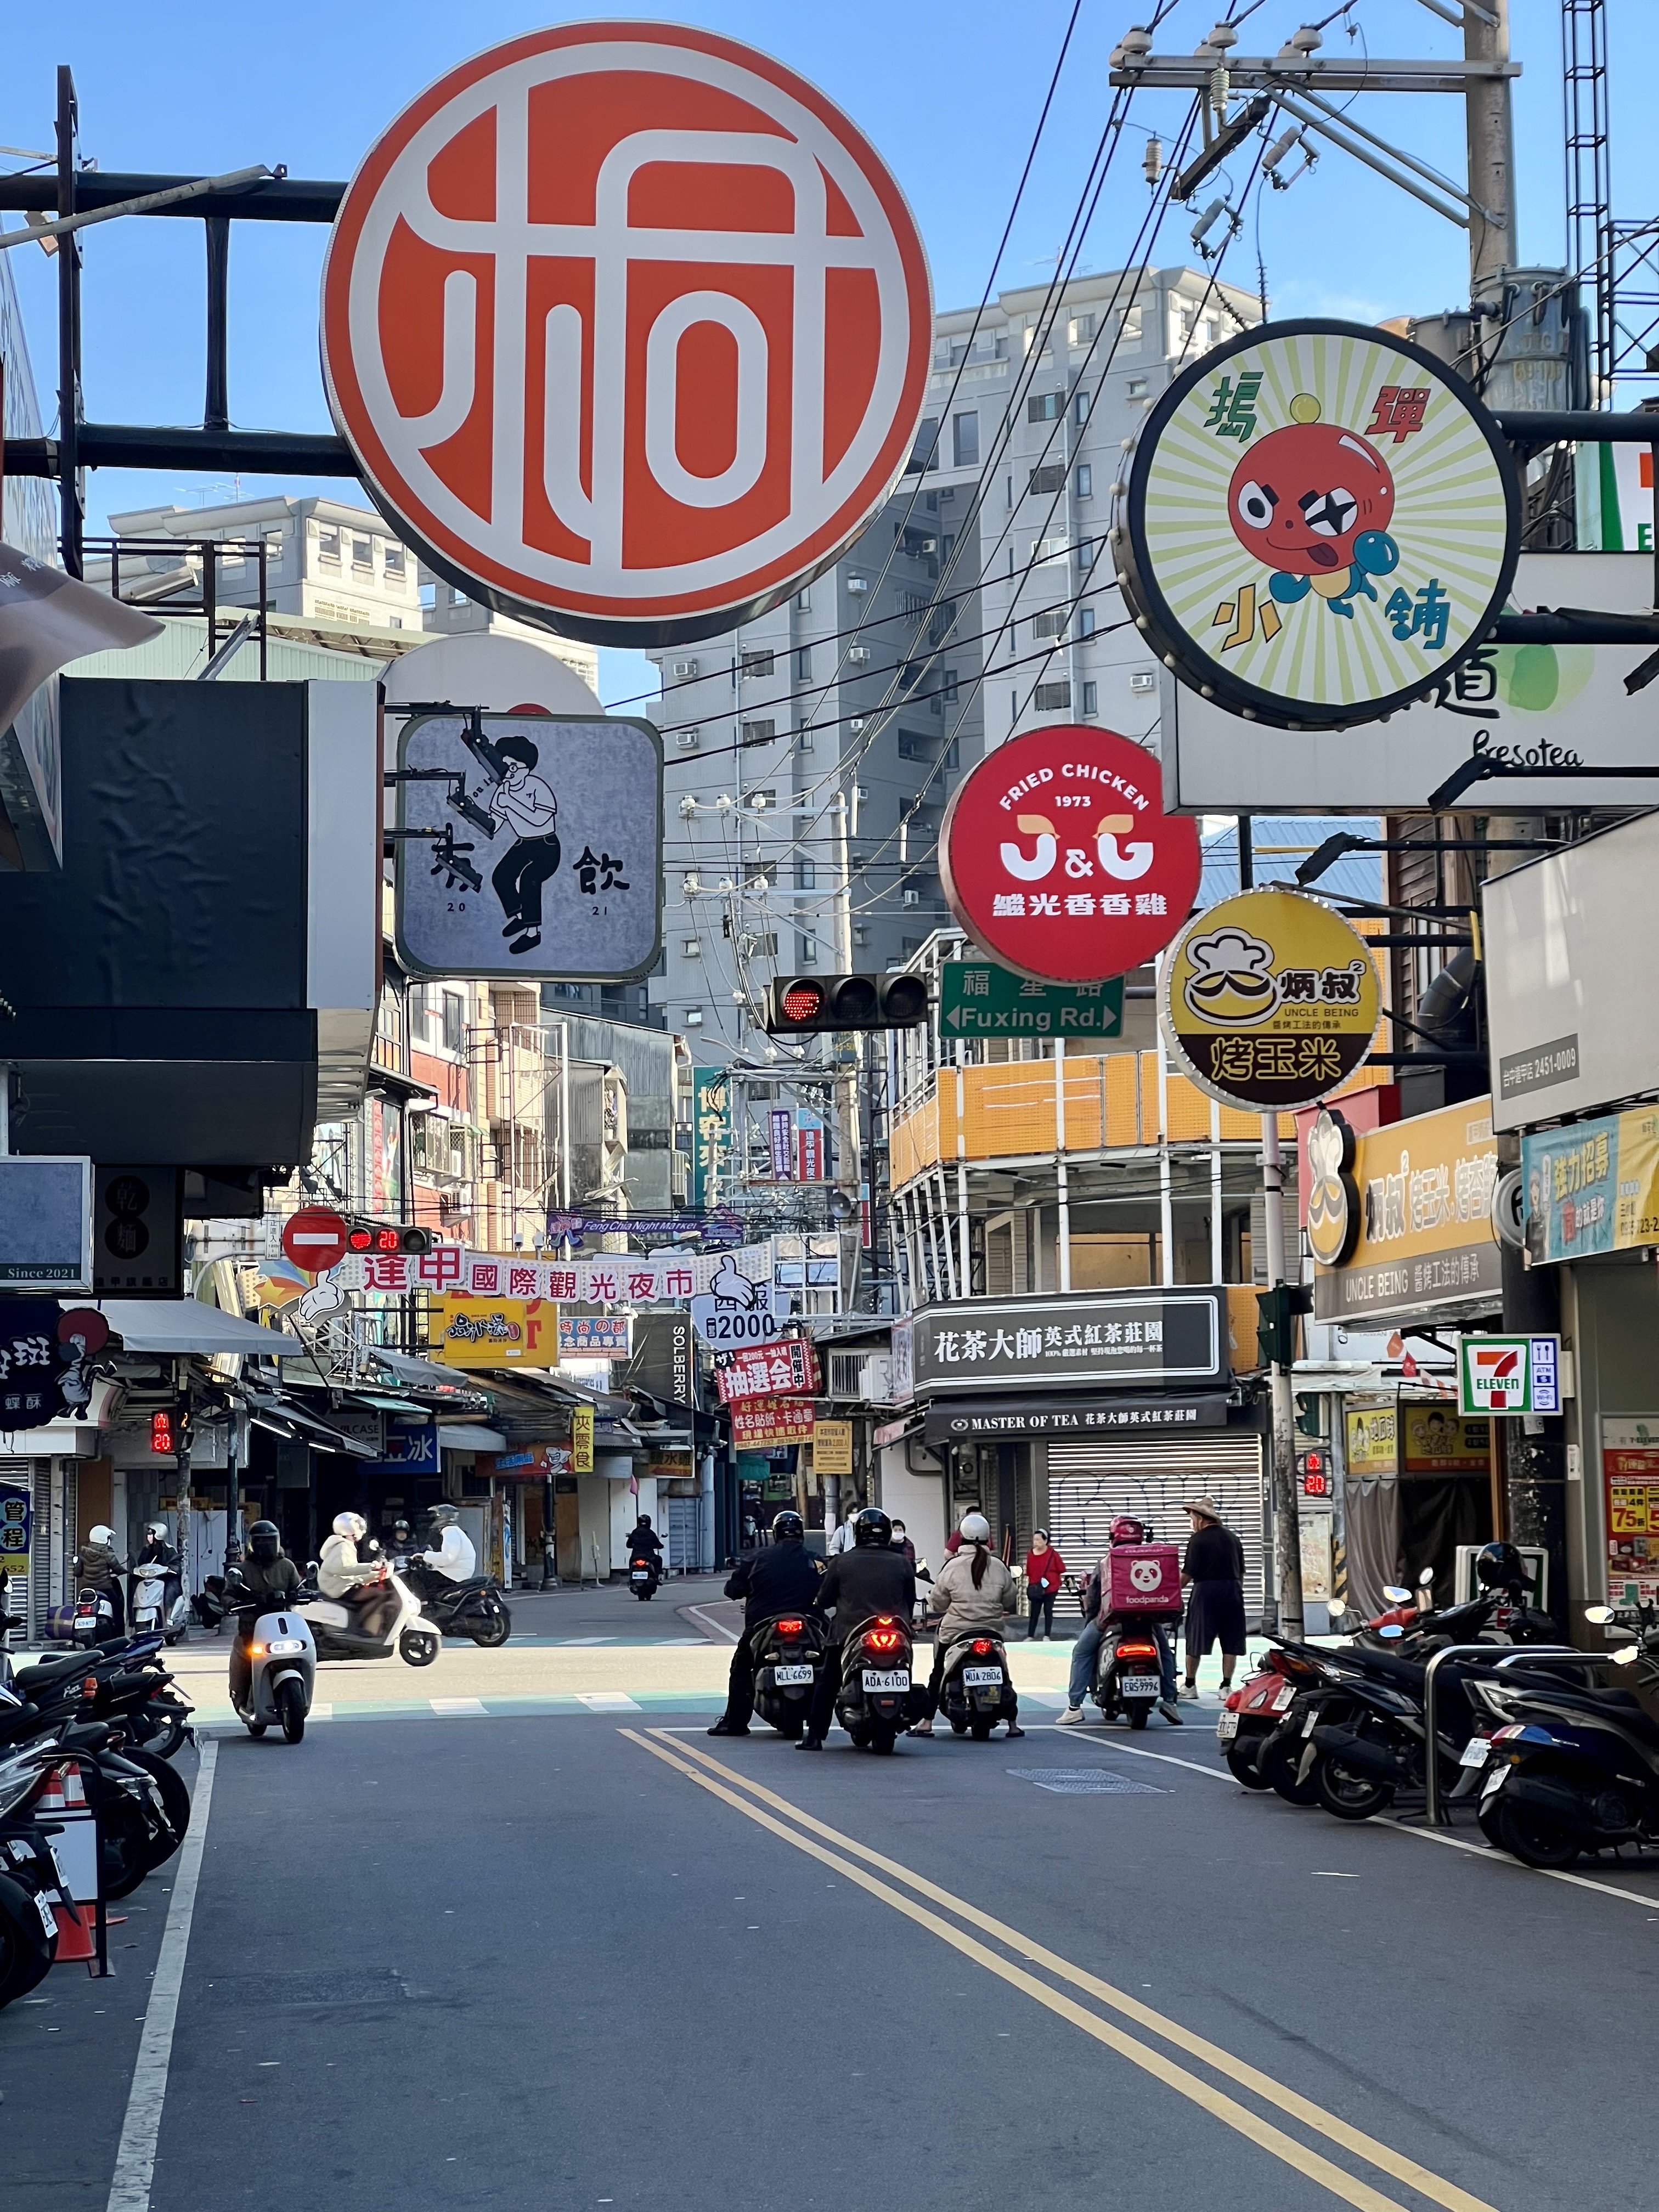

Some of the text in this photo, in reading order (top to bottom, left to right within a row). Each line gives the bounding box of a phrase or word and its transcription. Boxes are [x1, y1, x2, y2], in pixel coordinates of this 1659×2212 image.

[1214, 584, 1282, 652] 小
[1000, 763, 1150, 811] FRIED CHICKEN
[1055, 795, 1092, 807] 1973
[447, 902, 607, 916] 20 21
[961, 1007, 1102, 1031] Fuxing Rd.
[1284, 1008, 1359, 1017] UNCLE BEING
[1210, 1036, 1341, 1081] 烤玉米
[1534, 1047, 1577, 1079] 2451-0009
[805, 1131, 816, 1180] 逢甲觀光夜
[584, 1221, 609, 1232] Feng
[610, 1221, 631, 1232] Chia
[631, 1221, 659, 1232] Night
[660, 1222, 698, 1231] Market
[379, 1231, 399, 1249] 20
[8, 1268, 76, 1278] Since 2021
[364, 1248, 693, 1299] 逢甲國際觀光夜市
[1345, 1268, 1408, 1302] UNCLE BEING
[560, 1320, 626, 1334] 時尚の都
[718, 1313, 775, 1339] 2000
[933, 1328, 1043, 1363] 花茶大師
[1044, 1321, 1163, 1347] 英式紅茶莊園
[673, 1325, 687, 1404] SOLBERRY
[724, 1358, 792, 1398] 抽選会
[972, 1408, 1197, 1430] MASTER OF TEA 花茶大師英式紅茶莊園
[154, 1434, 170, 1450] 20
[575, 1414, 591, 1469] 夾零食
[1306, 1475, 1325, 1494] 20
[1126, 1594, 1170, 1606] foodpanda
